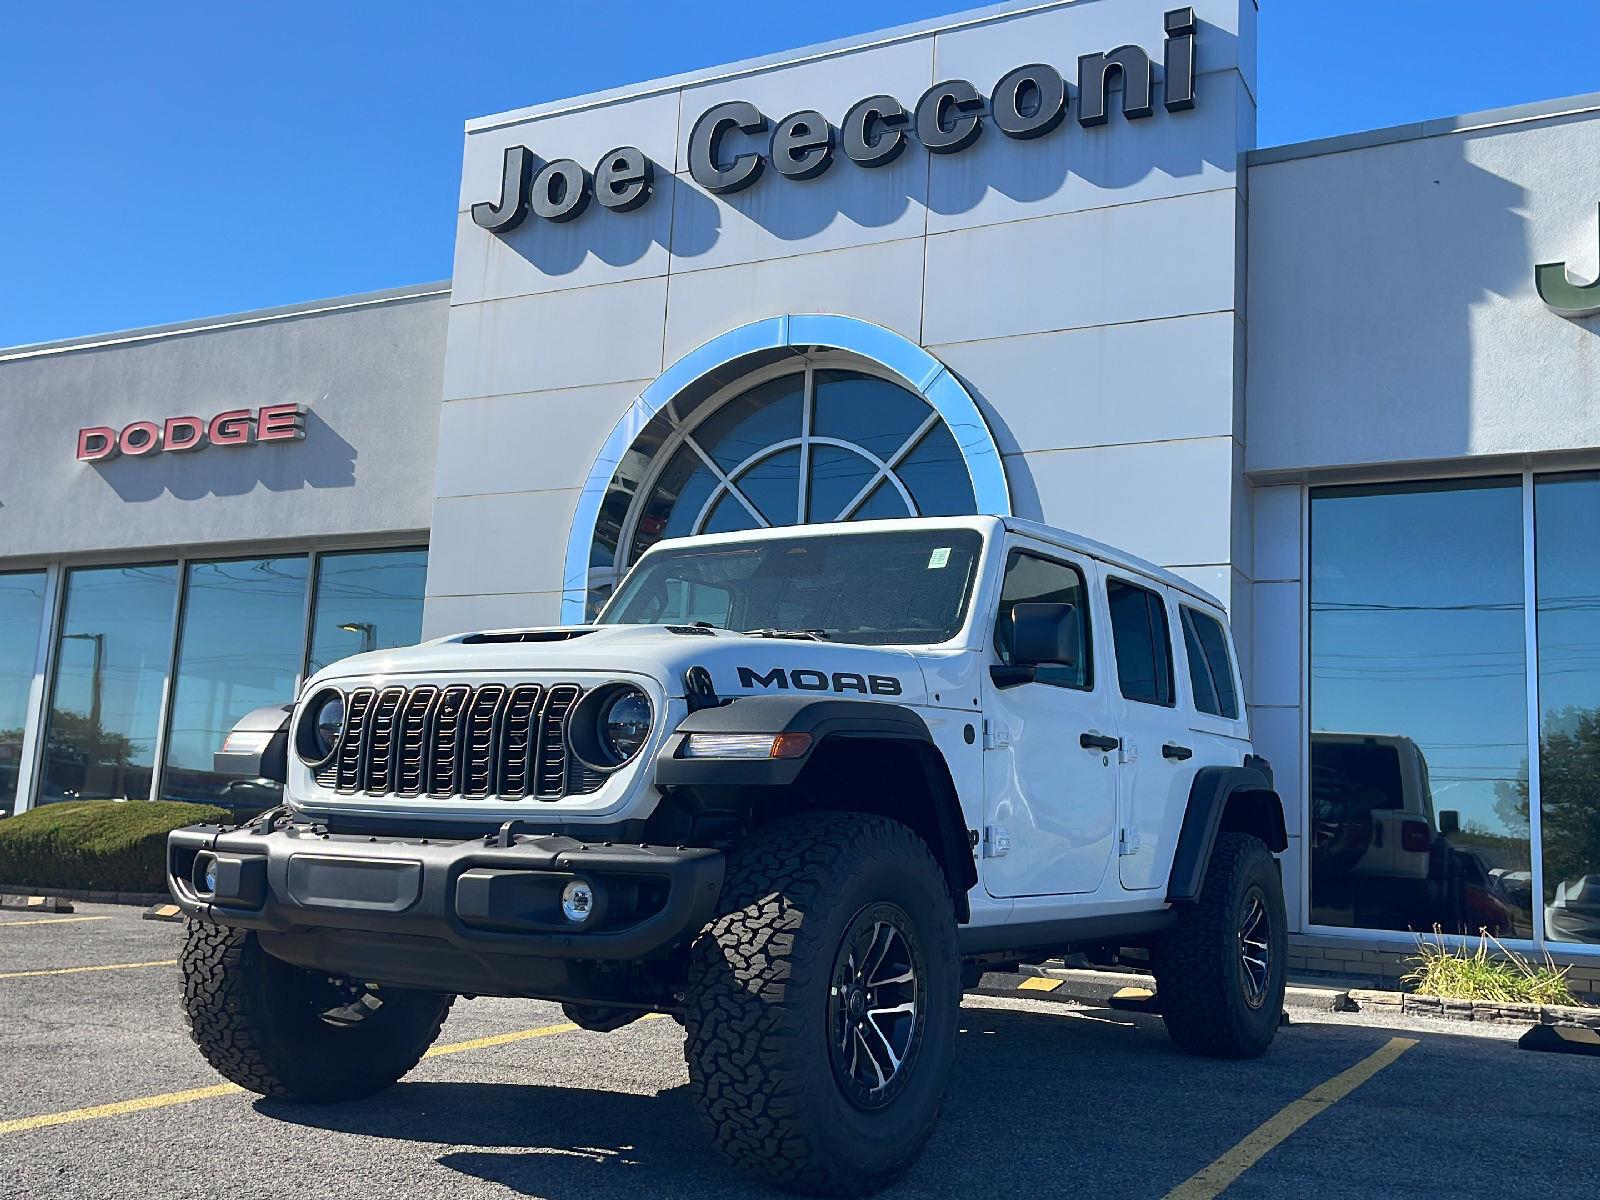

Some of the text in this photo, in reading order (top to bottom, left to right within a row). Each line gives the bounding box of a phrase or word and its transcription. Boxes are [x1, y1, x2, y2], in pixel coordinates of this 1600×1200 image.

[471, 6, 1197, 233] Joe Cecconi
[76, 402, 308, 461] DODGE
[736, 667, 902, 696] MOAB
